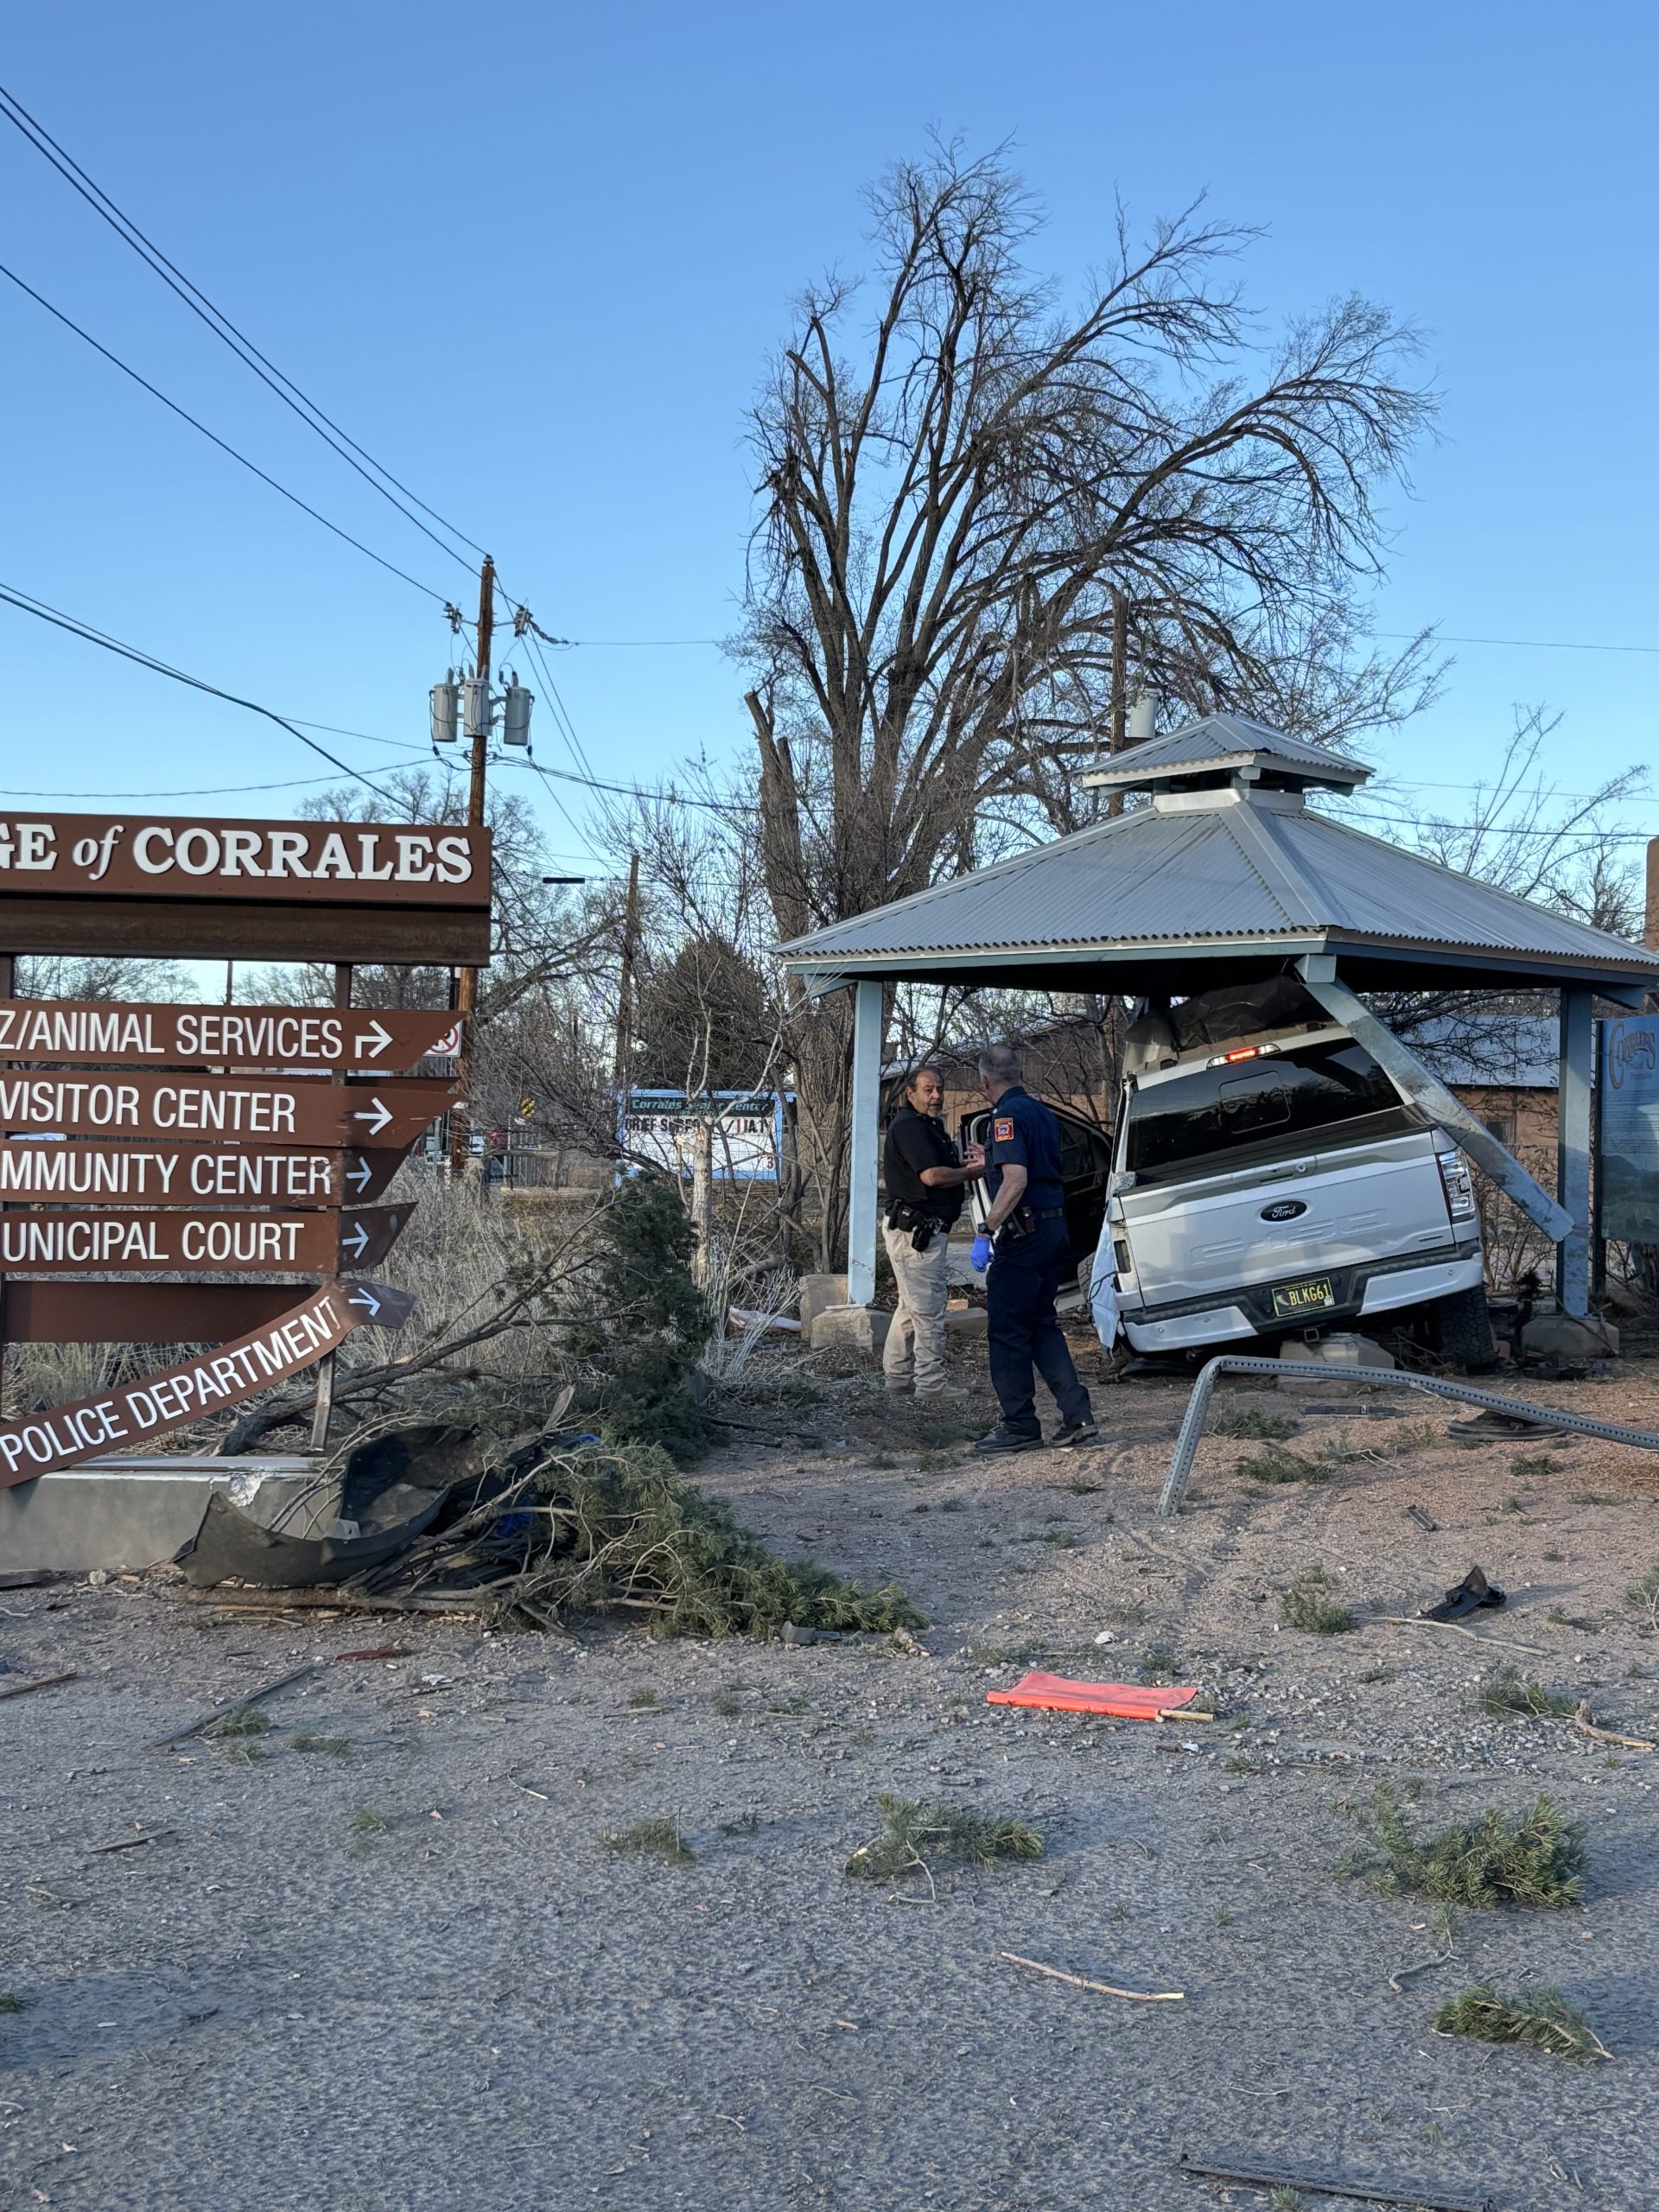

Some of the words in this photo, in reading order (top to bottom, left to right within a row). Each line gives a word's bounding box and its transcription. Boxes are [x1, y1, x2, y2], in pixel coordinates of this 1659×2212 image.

[73, 825, 124, 880] of
[133, 826, 473, 884] CORRALES
[0, 1010, 165, 1053] Z/ANIMAL
[175, 1014, 343, 1058] SERVICES
[0, 1080, 140, 1126] VISITOR
[154, 1087, 296, 1133] CENTER
[632, 1098, 683, 1110] Corrales
[0, 1151, 180, 1193] MMUNITY
[190, 1154, 333, 1195] CENTER
[1272, 1205, 1297, 1218] Ford
[3, 1221, 169, 1262] UNICIPAL
[181, 1221, 305, 1262] COURT
[1288, 1283, 1332, 1306] BLKG61
[0, 1401, 129, 1472] POLICE
[125, 1296, 342, 1429] DEPARTMENT
